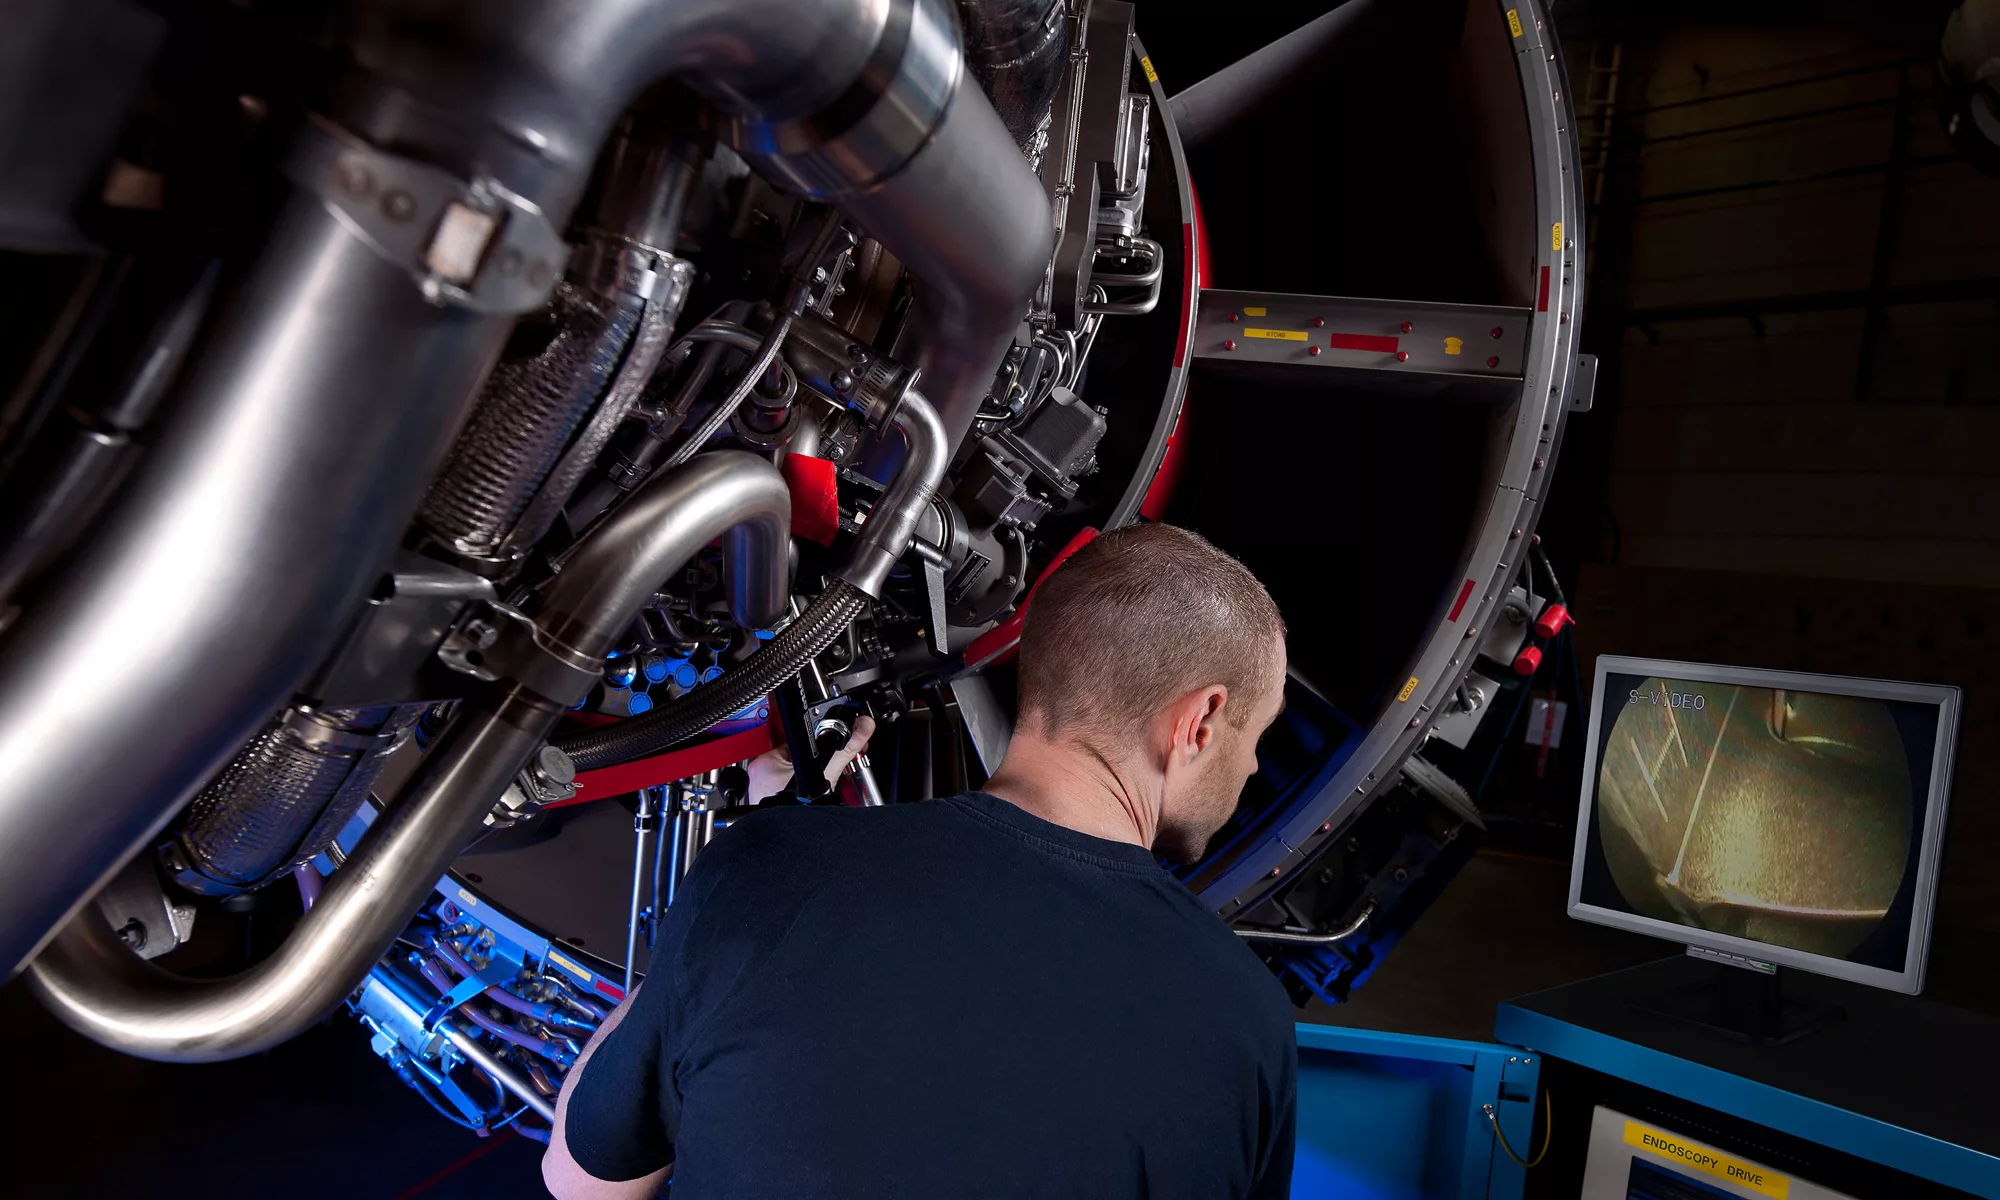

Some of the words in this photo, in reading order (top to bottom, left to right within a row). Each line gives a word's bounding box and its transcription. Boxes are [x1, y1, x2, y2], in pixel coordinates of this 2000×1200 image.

[1628, 689, 1705, 710] S-VIDEO
[1642, 1133, 1718, 1169] ENDOSCOPY
[1726, 1165, 1763, 1186] DRIVE
